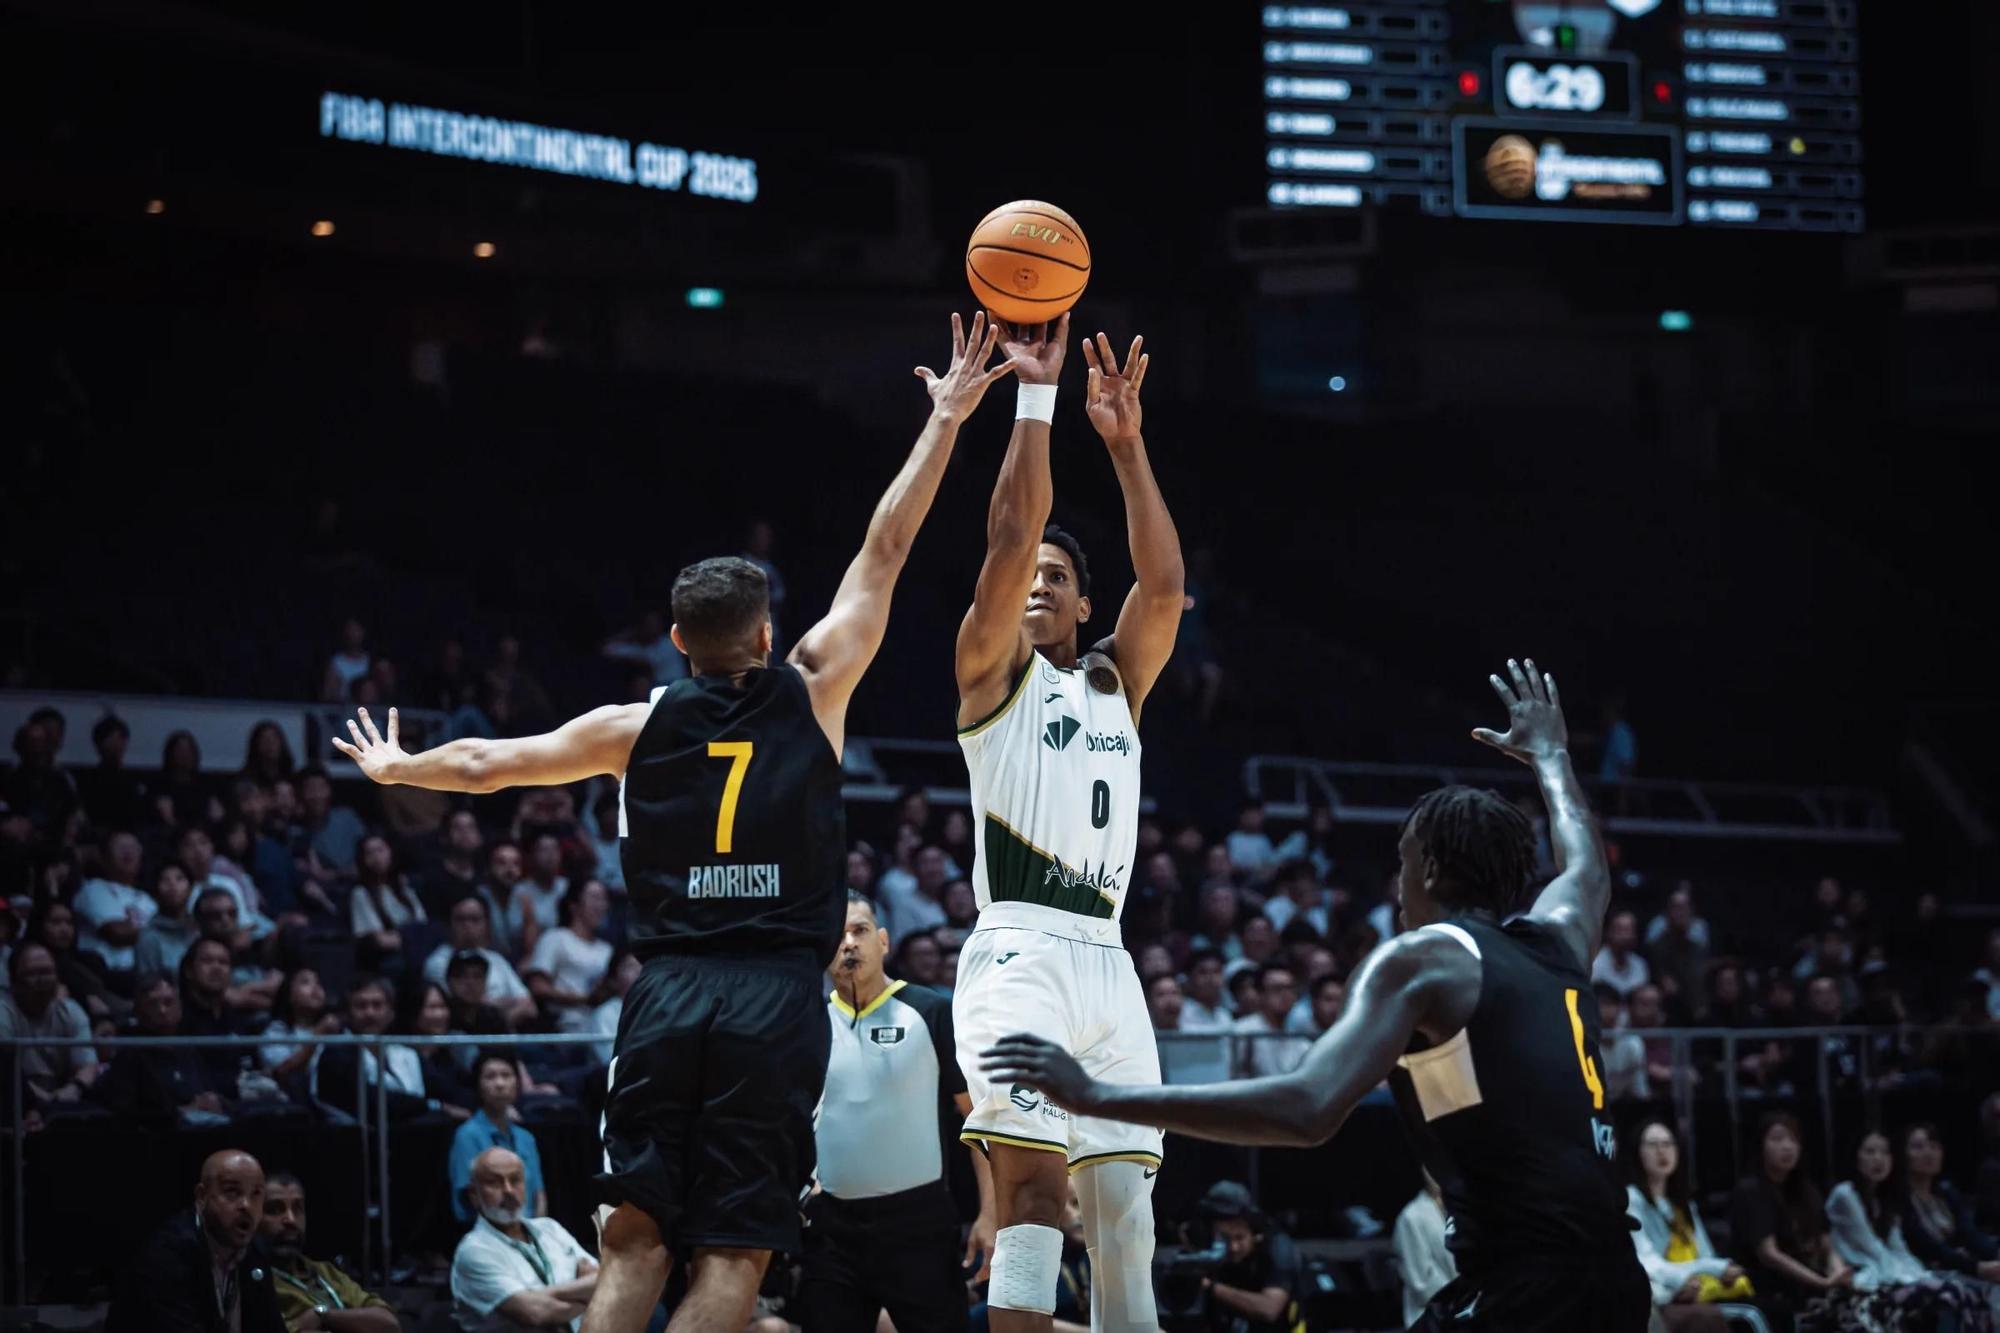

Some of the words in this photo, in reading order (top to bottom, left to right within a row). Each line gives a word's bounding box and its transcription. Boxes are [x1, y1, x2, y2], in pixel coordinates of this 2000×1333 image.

[1506, 62, 1605, 111] 6:29
[321, 92, 385, 144] FIBA
[388, 103, 636, 184] INTERCONTINENTAL
[636, 142, 689, 190] CUP
[689, 151, 758, 202] 2025
[707, 742, 753, 853] 7
[1091, 779, 1110, 829] 0
[687, 864, 780, 899] BADRUSH
